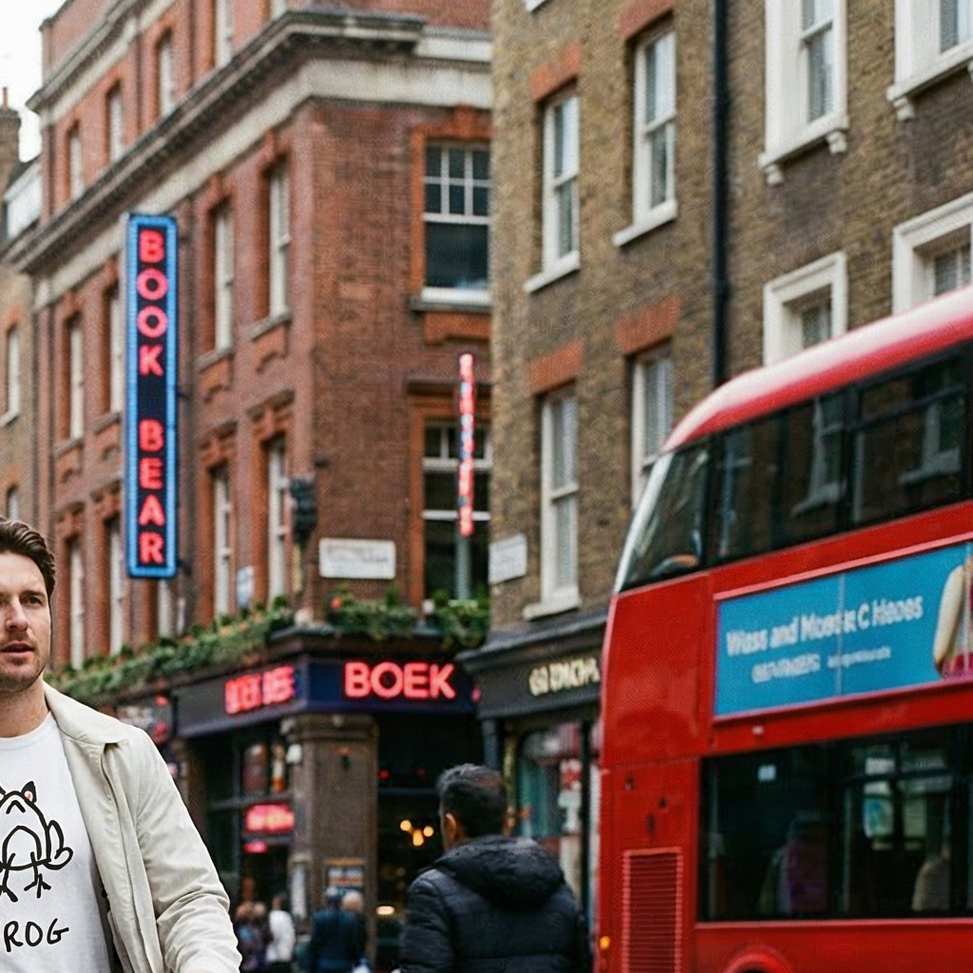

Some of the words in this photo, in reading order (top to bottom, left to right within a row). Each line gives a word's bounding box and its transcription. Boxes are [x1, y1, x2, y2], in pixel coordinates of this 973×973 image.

[137, 229, 169, 377] BOOK
[138, 419, 166, 565] BEAR
[344, 661, 457, 699] BOEK
